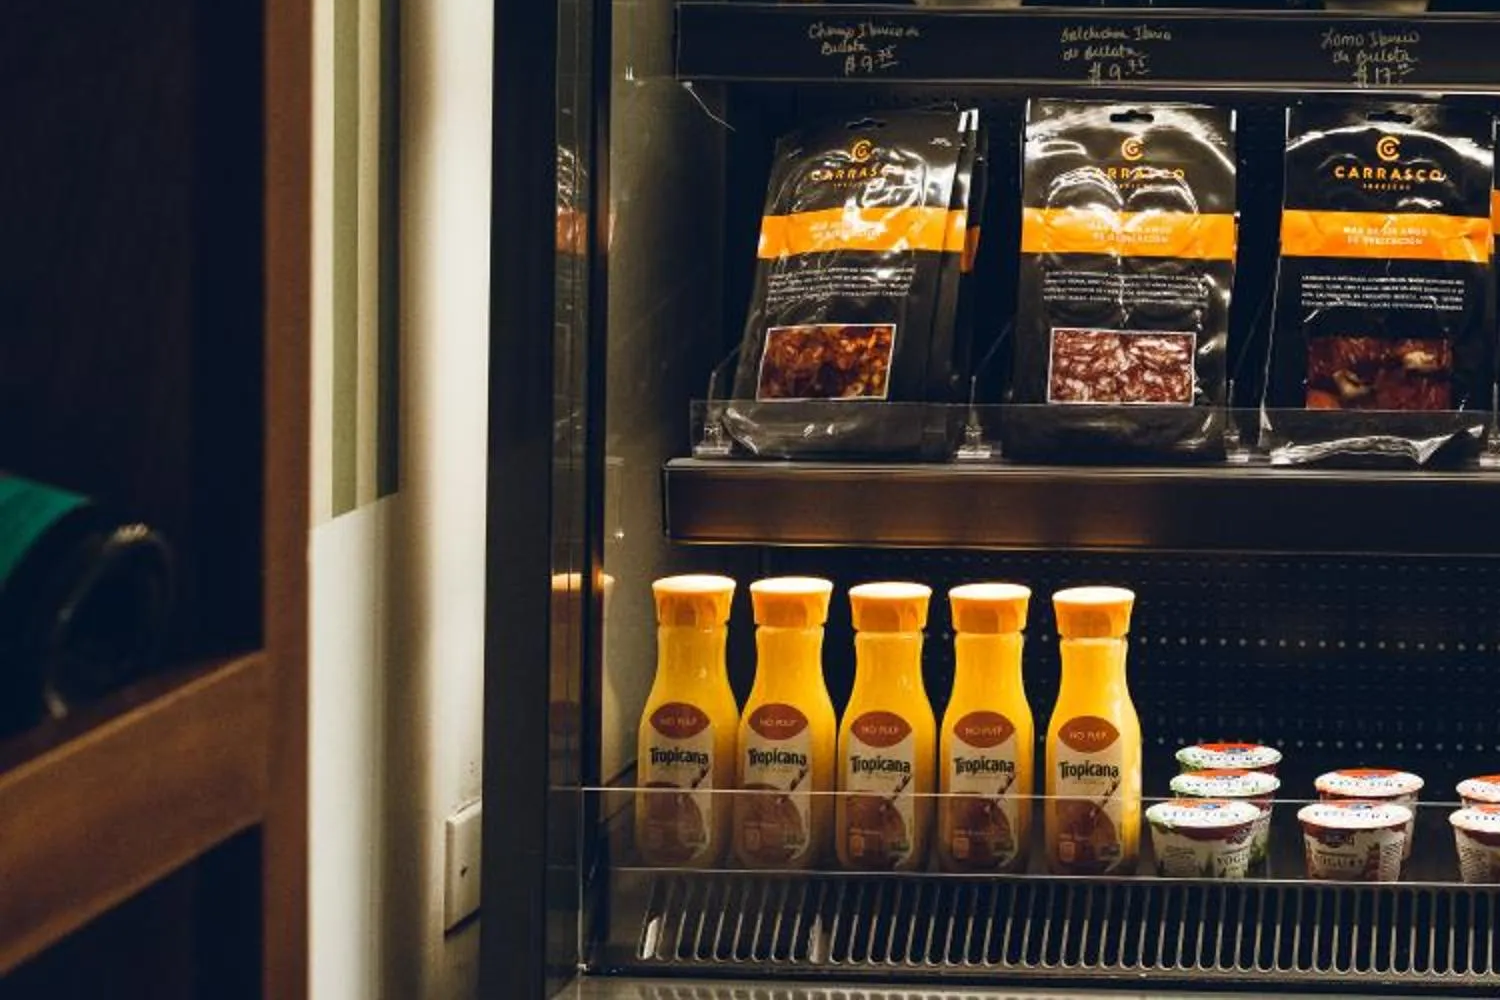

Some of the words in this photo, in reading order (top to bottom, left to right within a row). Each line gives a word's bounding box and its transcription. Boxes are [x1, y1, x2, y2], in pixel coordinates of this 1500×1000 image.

[1335, 166, 1441, 182] CARRASCO
[650, 747, 709, 766] Tropicana
[748, 747, 807, 766] Tropicana
[850, 755, 911, 774] Tropicana
[954, 756, 1015, 775] Tropicana
[1059, 760, 1119, 779] Tropicana
